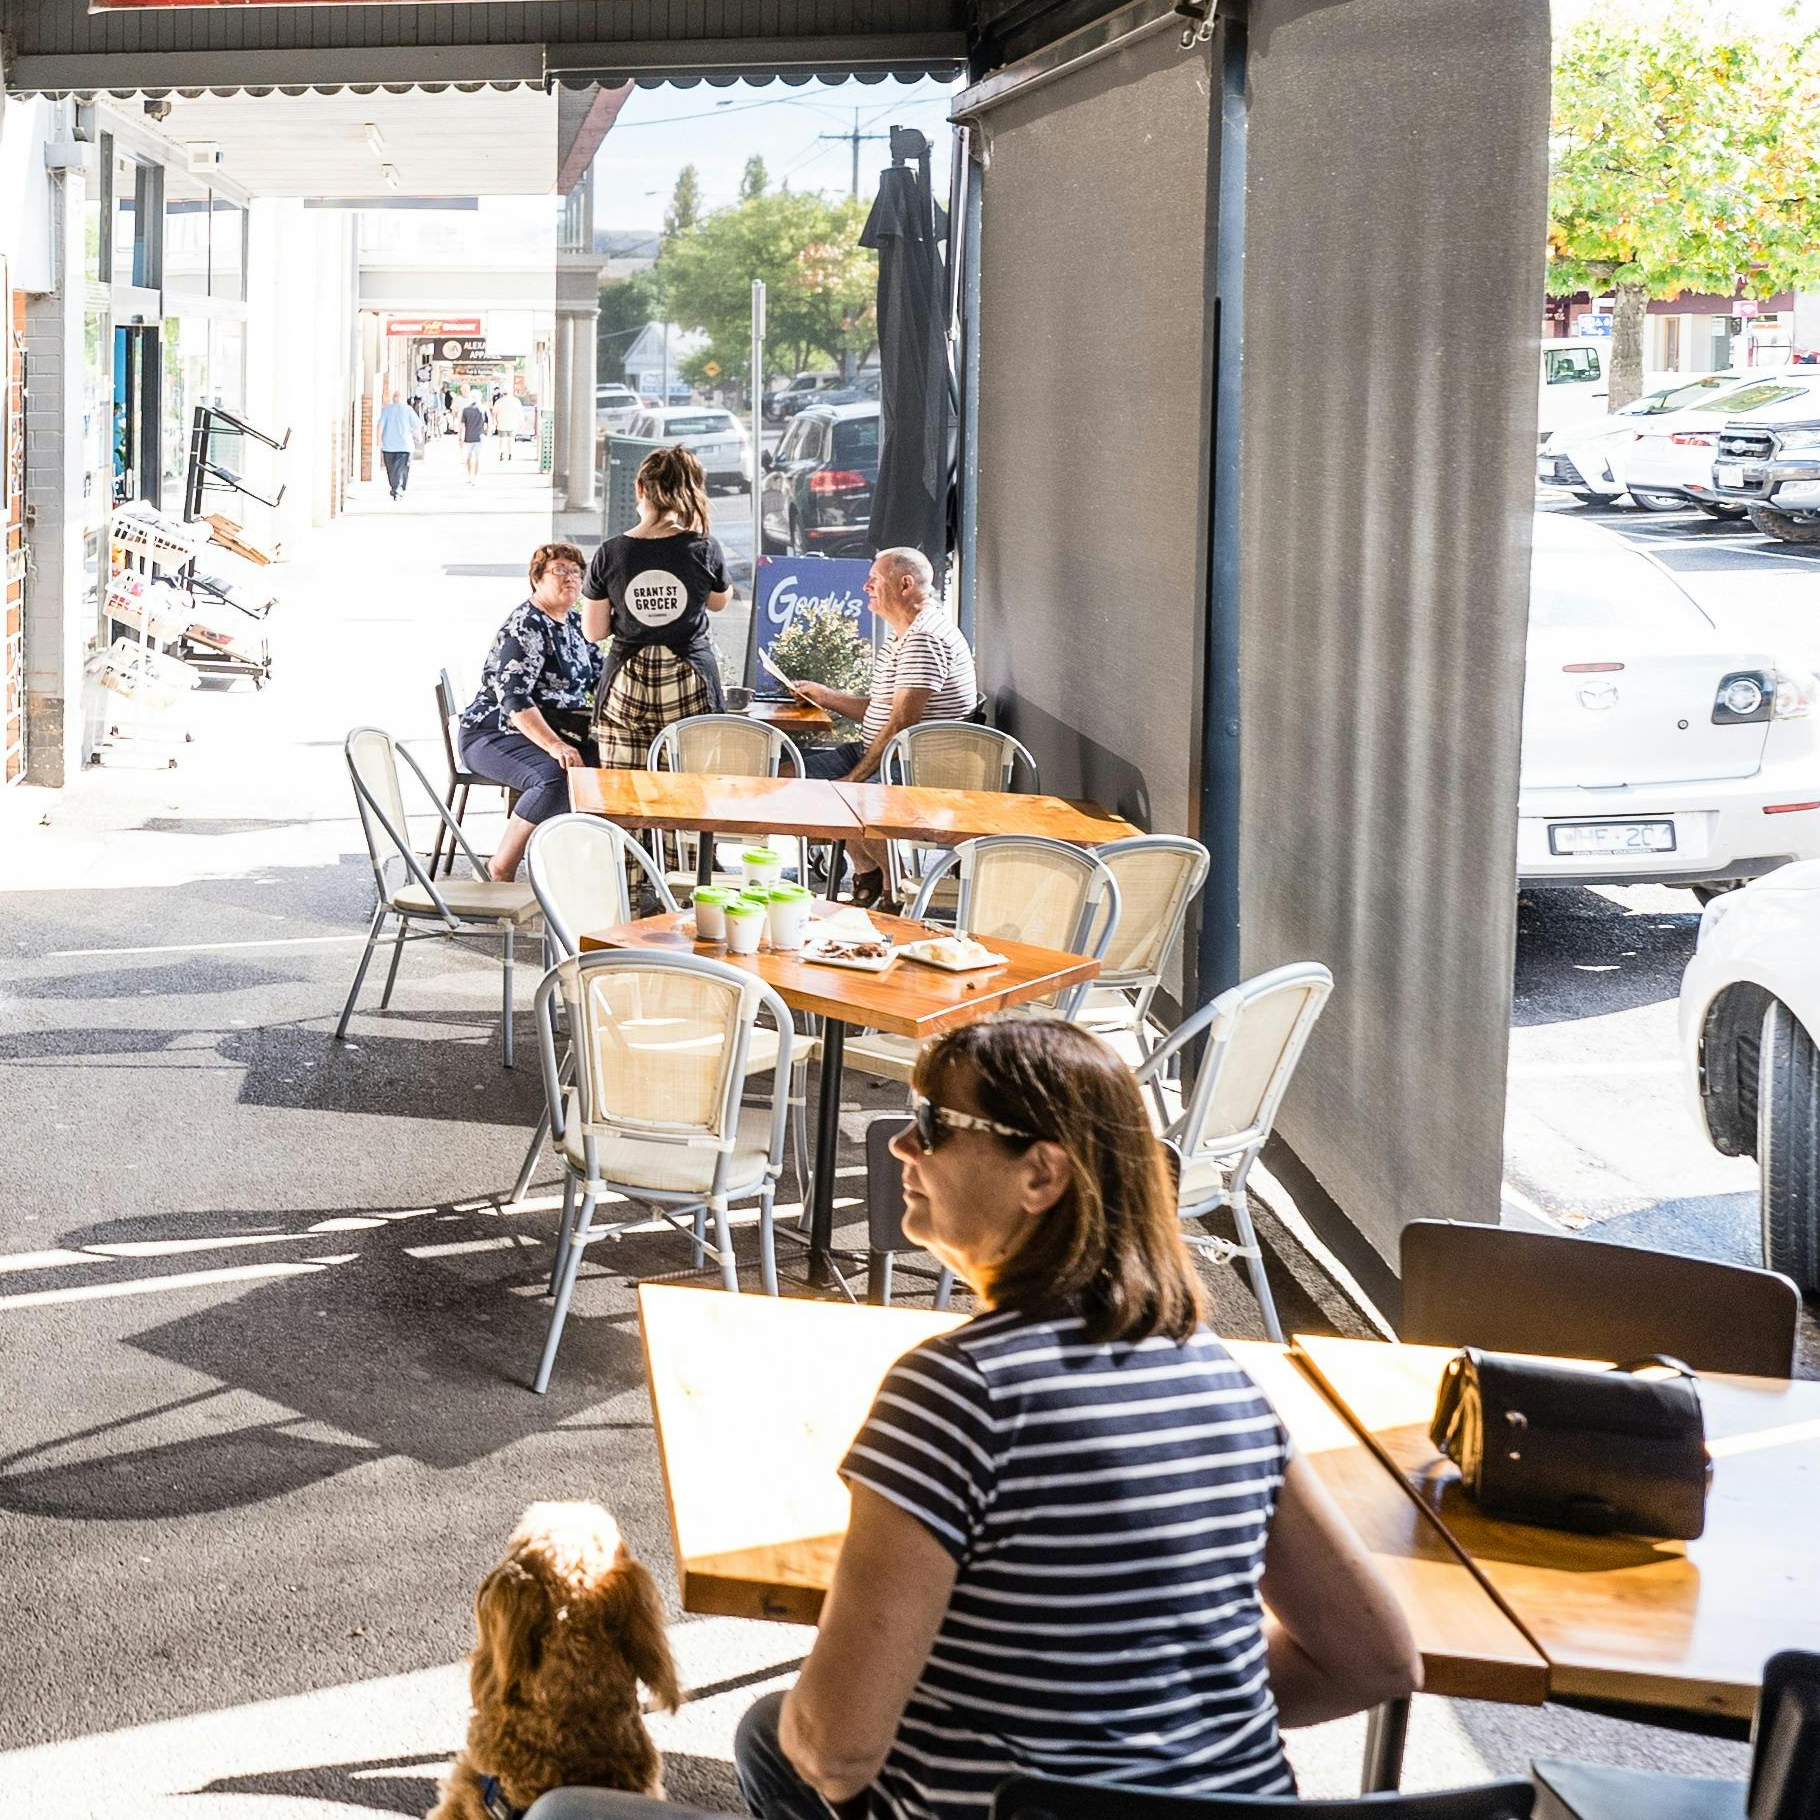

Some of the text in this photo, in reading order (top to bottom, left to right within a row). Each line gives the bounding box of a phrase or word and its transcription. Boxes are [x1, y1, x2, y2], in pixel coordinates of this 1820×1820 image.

[633, 585, 678, 599] GRANT ST
[635, 597, 678, 611] GROCER
